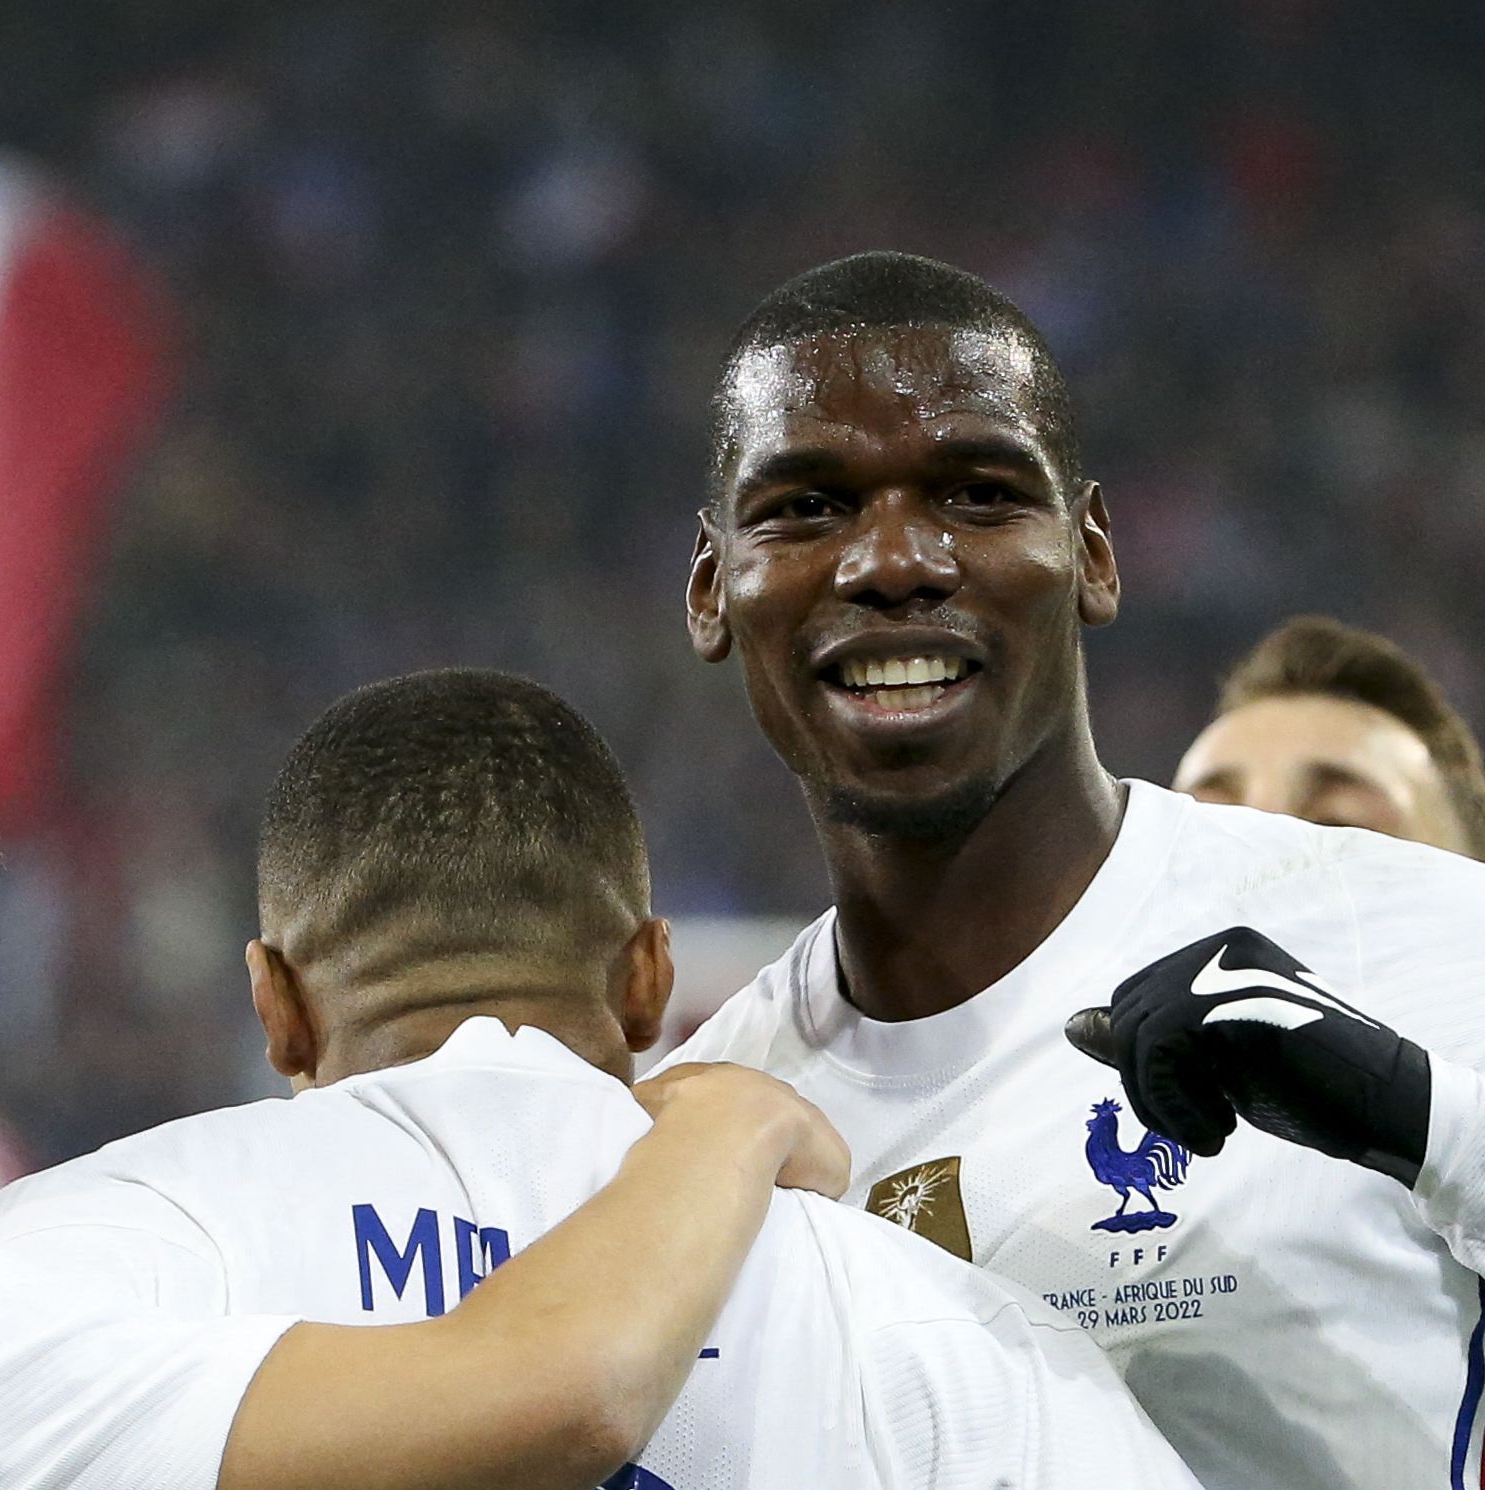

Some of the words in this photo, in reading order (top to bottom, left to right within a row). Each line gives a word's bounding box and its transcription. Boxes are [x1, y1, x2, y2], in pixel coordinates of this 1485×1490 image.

[1114, 1281, 1177, 1304] AFRIQUE
[1183, 1277, 1204, 1297] DU
[1210, 1274, 1238, 1295] SUD
[1077, 1309, 1099, 1329] 29
[1105, 1305, 1147, 1328] MARS
[1153, 1299, 1204, 1322] 2022
